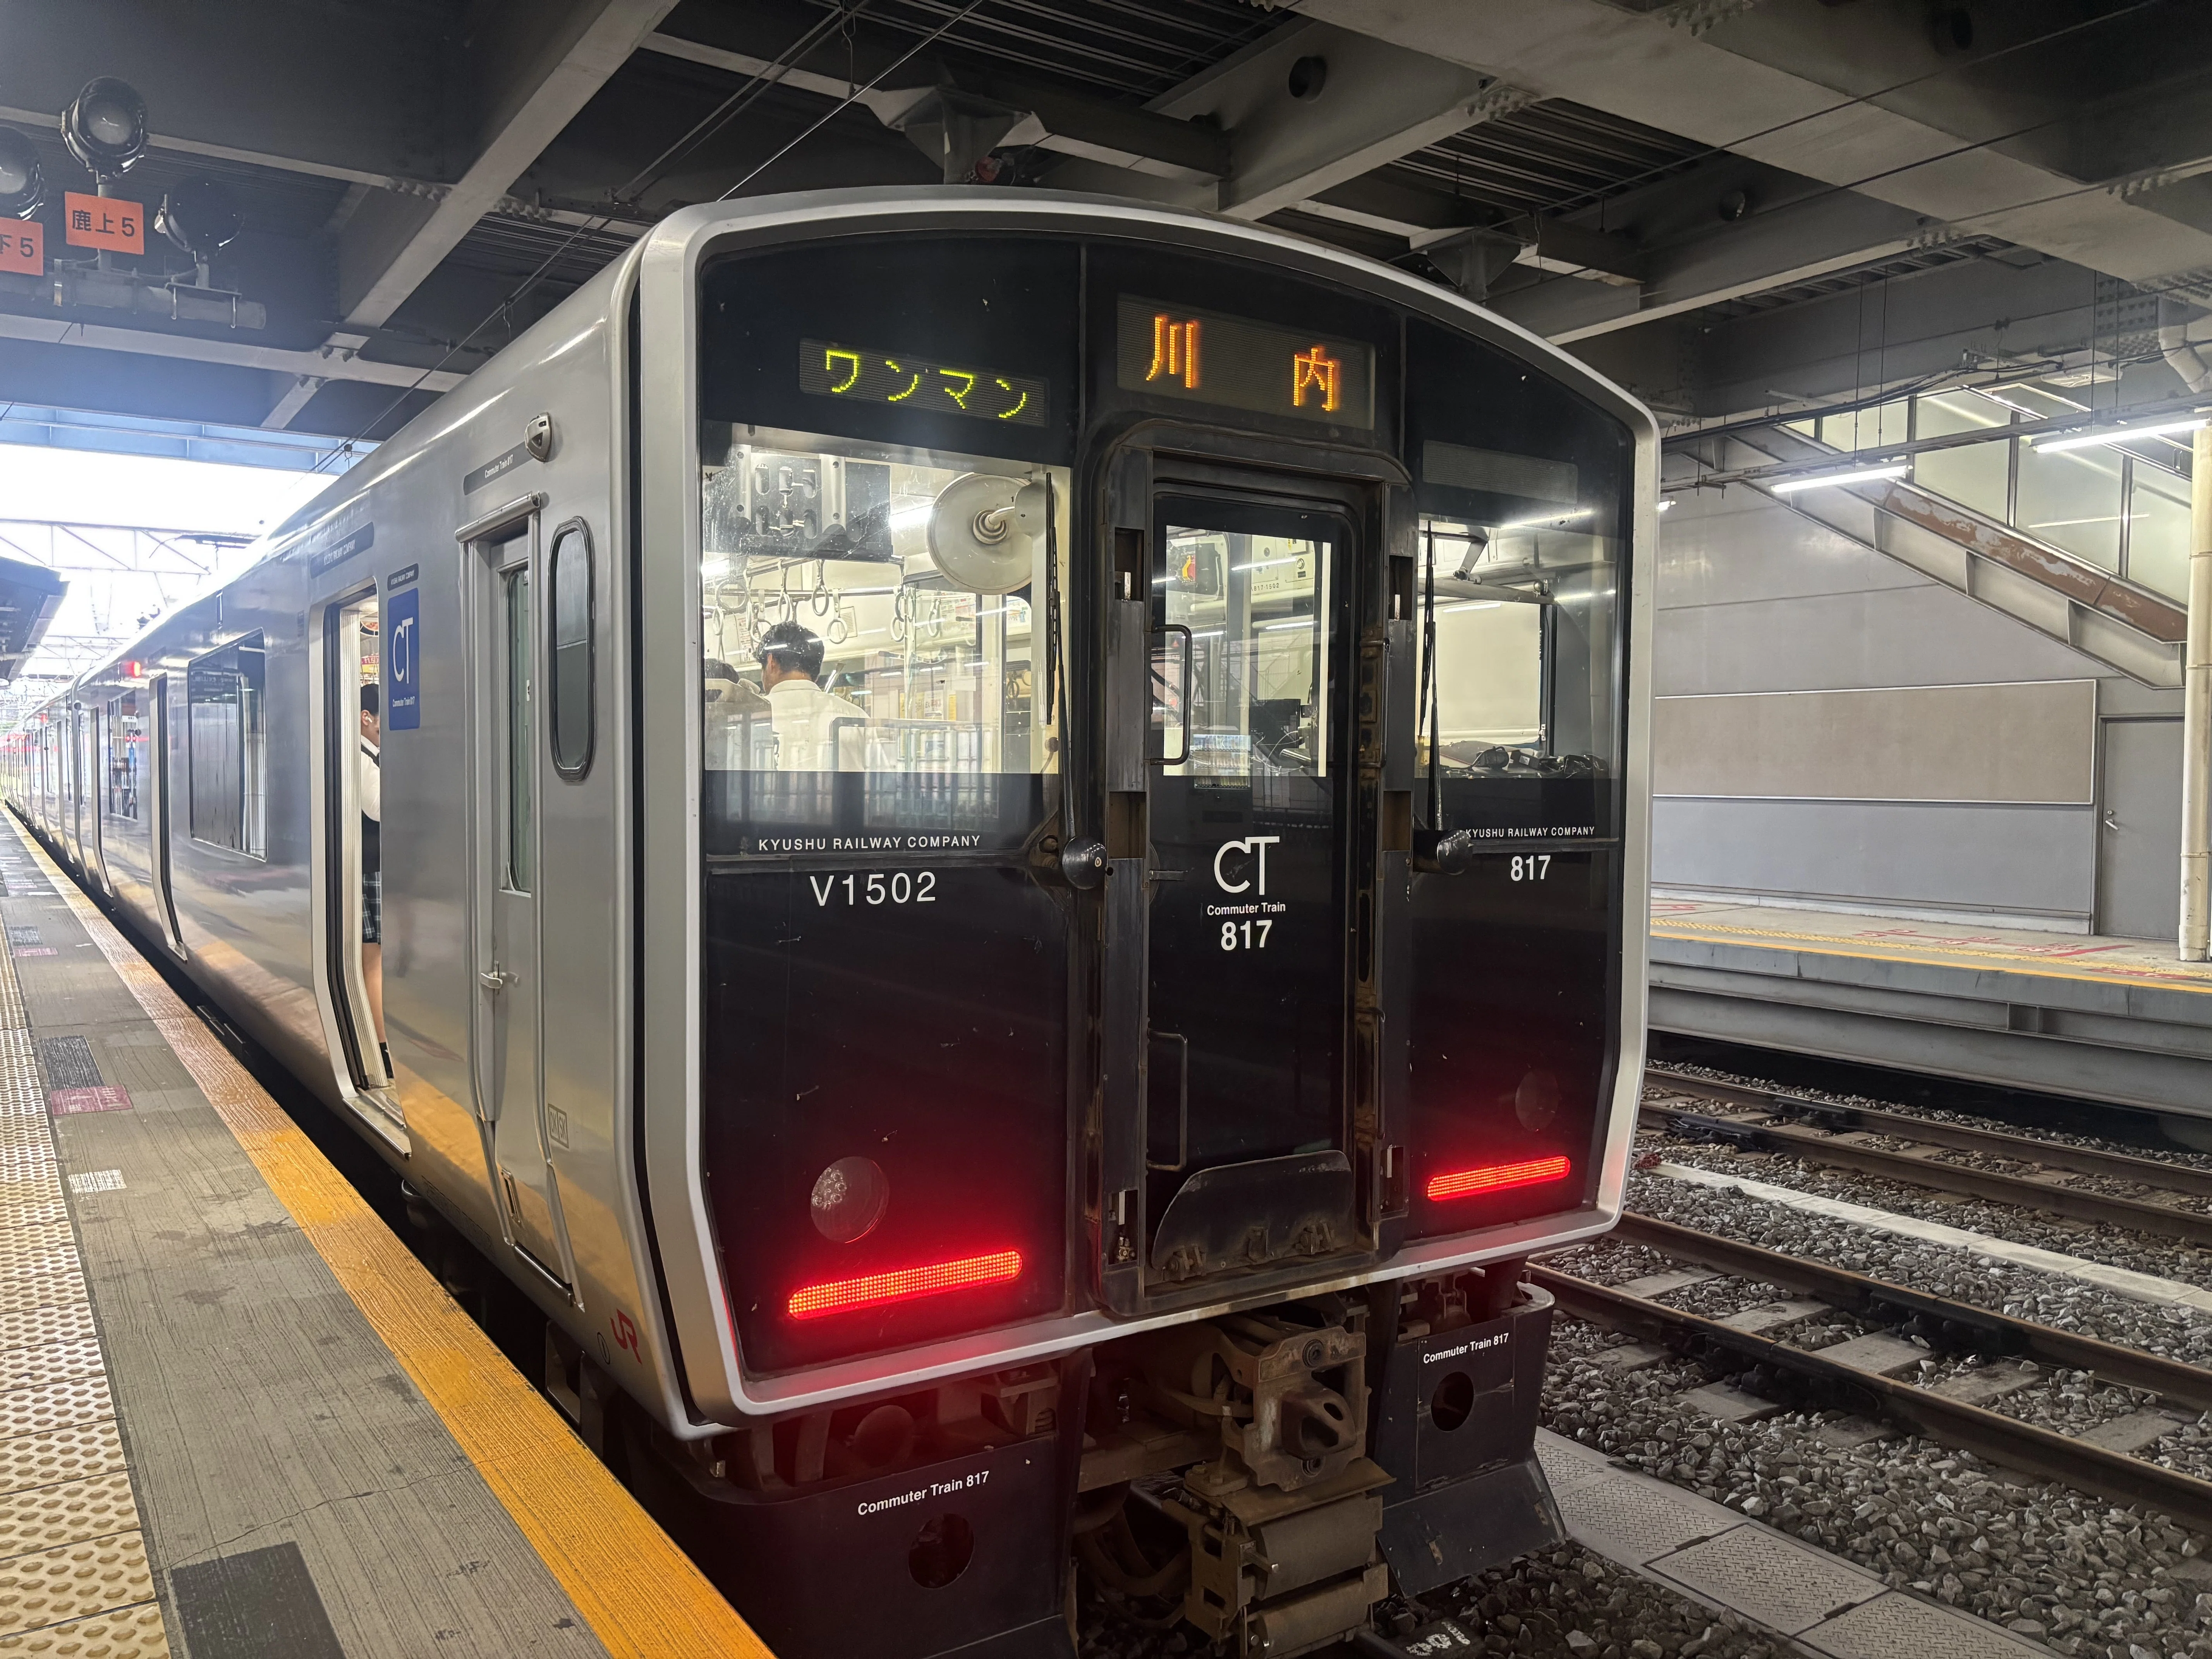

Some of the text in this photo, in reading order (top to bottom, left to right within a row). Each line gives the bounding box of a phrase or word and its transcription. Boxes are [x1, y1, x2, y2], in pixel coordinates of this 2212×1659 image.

[72, 209, 135, 237] 鹿上5
[826, 350, 1027, 418] ワンマン
[393, 617, 413, 684] CT
[759, 835, 980, 851] KYUSHU RAILWAY COMPANY
[1466, 826, 1594, 838] KYUSHU RAILWAY COMPANY
[1214, 836, 1280, 895] CT
[1511, 855, 1551, 881] 817
[809, 871, 936, 906] V1502
[1207, 902, 1286, 915] Commuter Train
[1221, 920, 1272, 951] 817
[610, 1308, 642, 1365] JR
[1423, 1332, 1509, 1364] Commuter Train 817
[858, 1470, 989, 1515] Commuter Train 817
